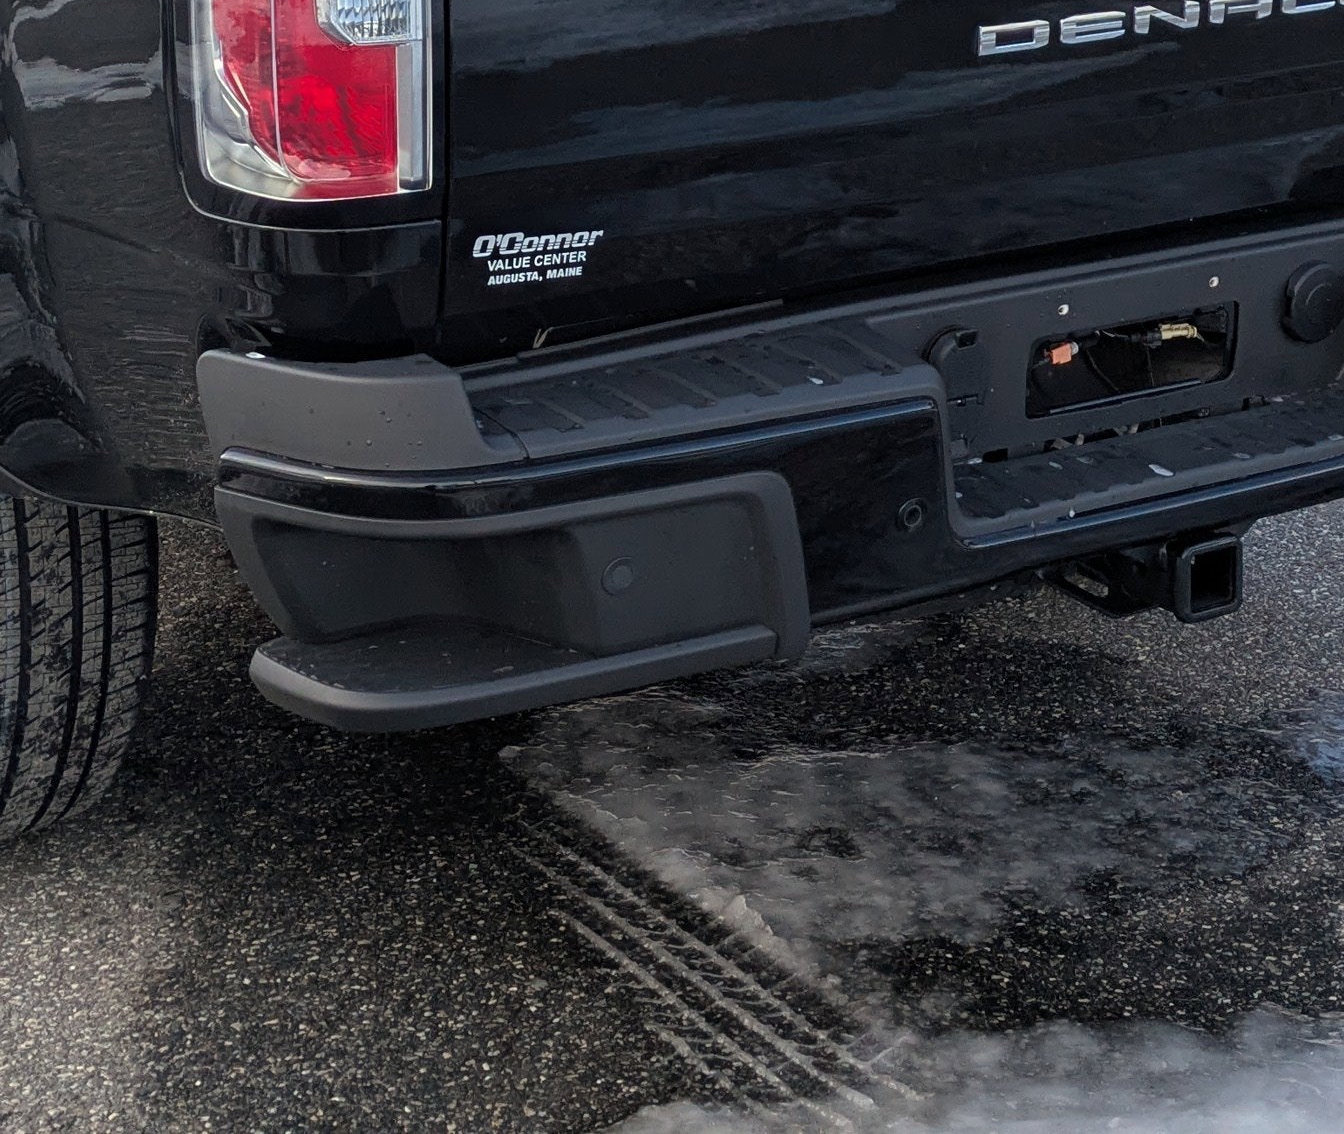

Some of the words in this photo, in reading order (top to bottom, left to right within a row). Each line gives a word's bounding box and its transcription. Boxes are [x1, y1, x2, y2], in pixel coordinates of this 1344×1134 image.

[472, 230, 604, 257] O'Connor
[487, 256, 531, 271] VALUE
[534, 250, 587, 266] CENTER
[487, 271, 543, 286] AUGUSTA,
[546, 266, 583, 279] MAINE
